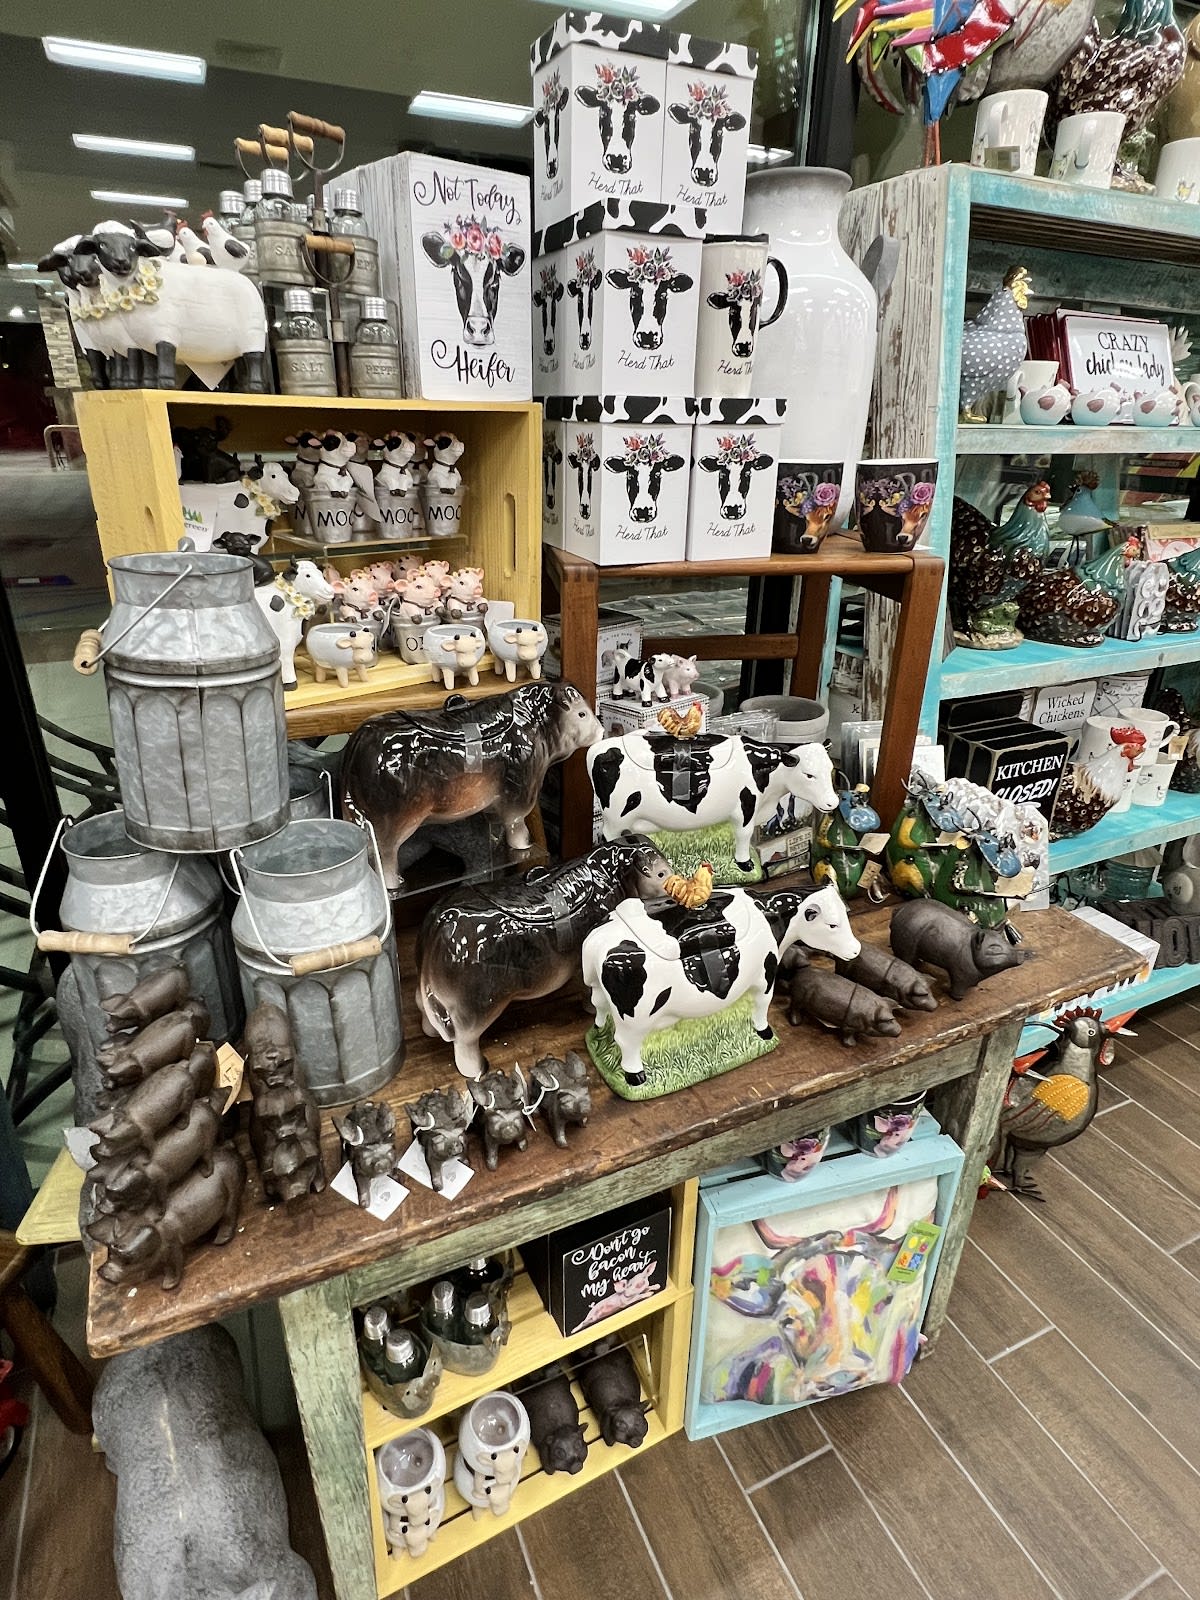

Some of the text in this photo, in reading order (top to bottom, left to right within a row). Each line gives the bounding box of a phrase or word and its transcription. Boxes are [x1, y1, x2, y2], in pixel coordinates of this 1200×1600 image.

[588, 172, 644, 196] Herd That
[413, 170, 522, 225] Not Today
[676, 184, 728, 207] Herd That
[275, 245, 302, 257] SAL
[1097, 331, 1149, 353] CRAZY
[291, 362, 325, 374] SALT
[431, 339, 516, 388] Heifer
[617, 350, 675, 370] Herd That
[717, 359, 743, 375] Herd
[1086, 351, 1133, 375] chic
[615, 525, 669, 541] Herd That
[706, 522, 756, 538] Herd That
[1047, 691, 1086, 710] Wicked
[1039, 708, 1086, 725] Chickens
[995, 754, 1065, 781] KITCHEN
[631, 1226, 650, 1245] go
[580, 1249, 657, 1298] my heart
[588, 1246, 637, 1280] bacon
